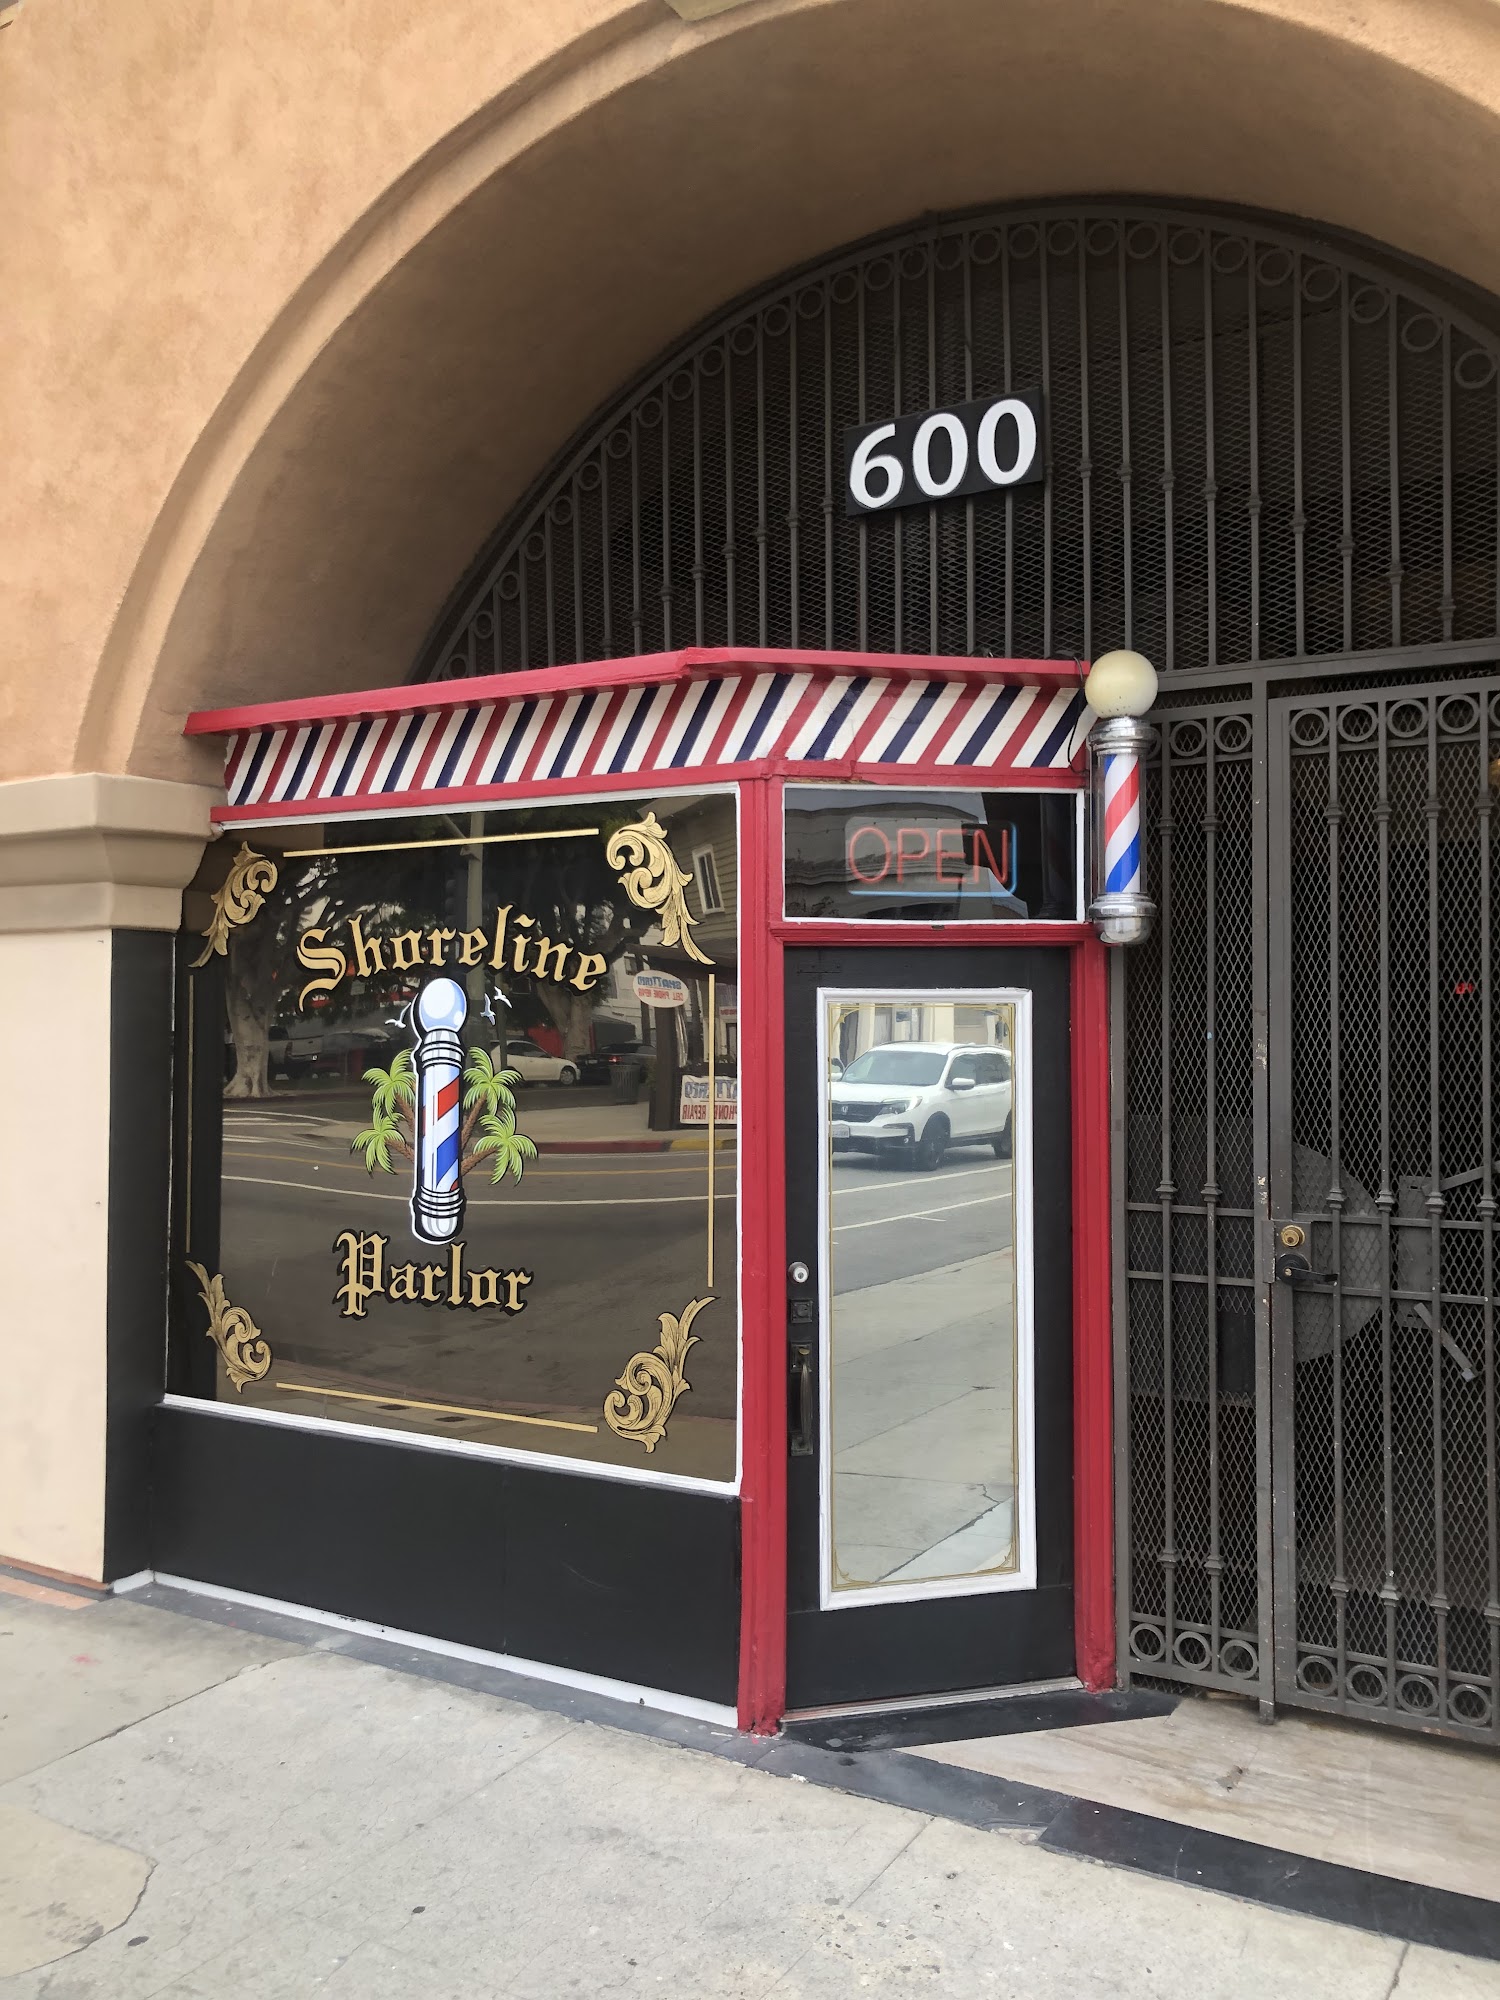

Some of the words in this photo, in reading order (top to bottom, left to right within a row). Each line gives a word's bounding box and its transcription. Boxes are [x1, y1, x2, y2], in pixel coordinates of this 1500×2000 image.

[849, 398, 1037, 509] 600
[848, 826, 1008, 885] OPEN
[296, 903, 608, 1012] Shoreline
[334, 1230, 532, 1318] Parlor
